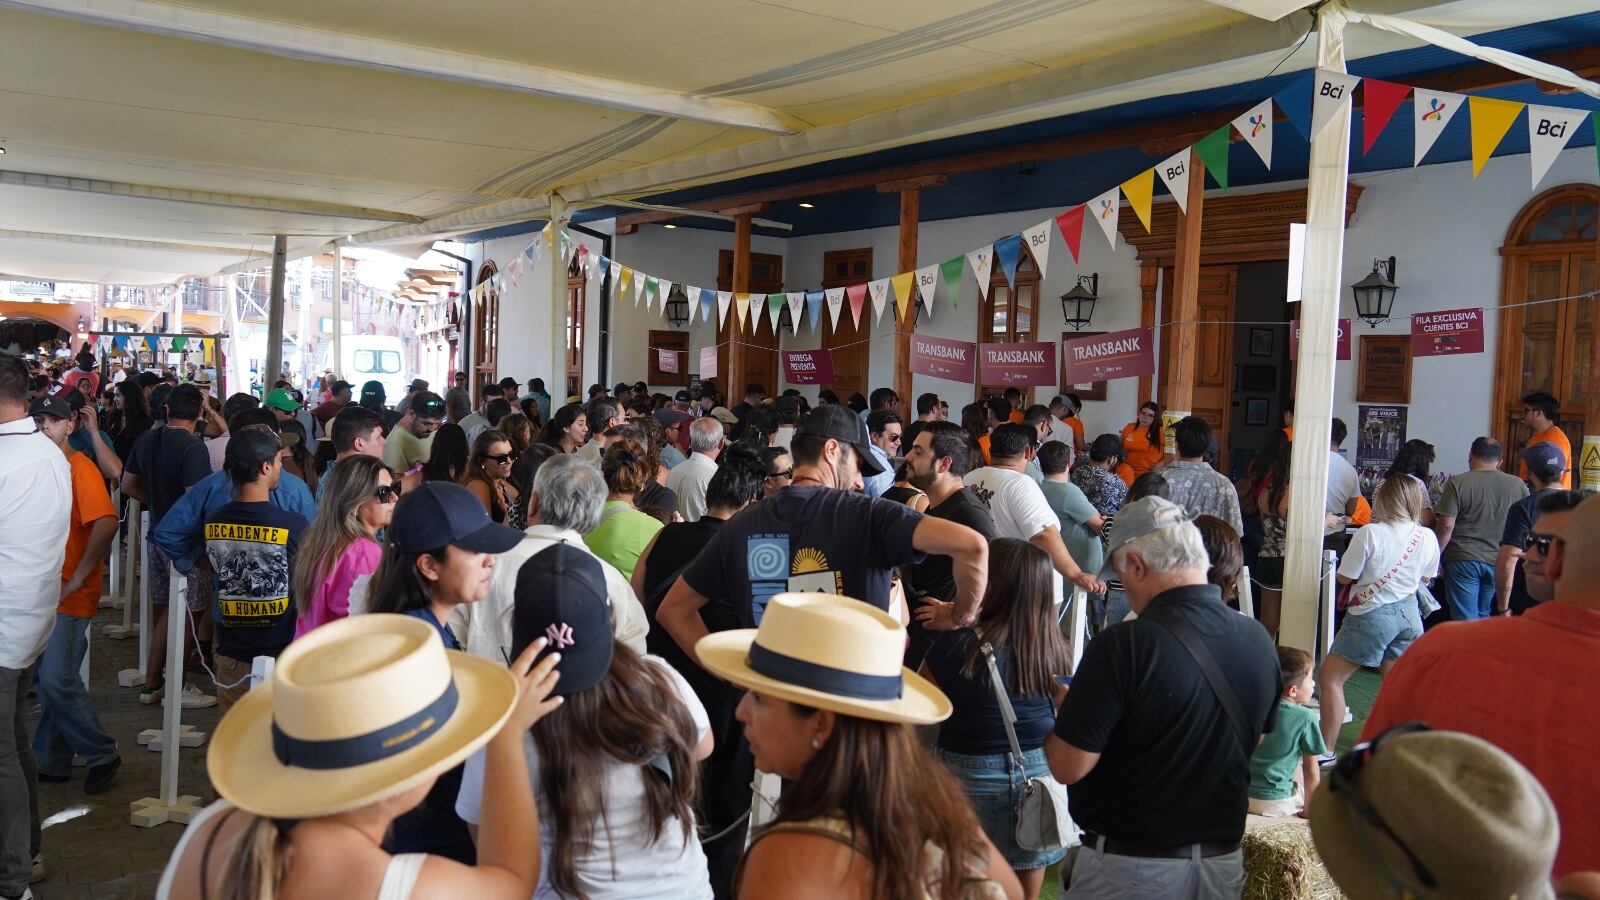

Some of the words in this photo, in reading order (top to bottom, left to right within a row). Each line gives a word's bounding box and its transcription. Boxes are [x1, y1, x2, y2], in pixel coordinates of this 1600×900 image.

[1319, 81, 1345, 100] Bci
[1536, 119, 1568, 138] Bci
[1166, 160, 1186, 181] Bci
[1031, 230, 1047, 247] Bci
[921, 273, 934, 285] Bci
[1415, 316, 1431, 325] FILA
[1432, 311, 1478, 323] EXCLUSIVA
[1423, 323, 1454, 332] CLIENTES
[1455, 322, 1469, 330] BCI
[916, 341, 966, 361] TRANSBANK
[987, 350, 1045, 363] TRANSBANK
[1073, 336, 1141, 360] TRANSBANK
[788, 353, 814, 362] ENTREGA
[790, 362, 817, 371] PREVENTA
[209, 524, 279, 542] DECADENTE
[236, 600, 285, 615] HUMANA
[545, 622, 576, 649] NY
